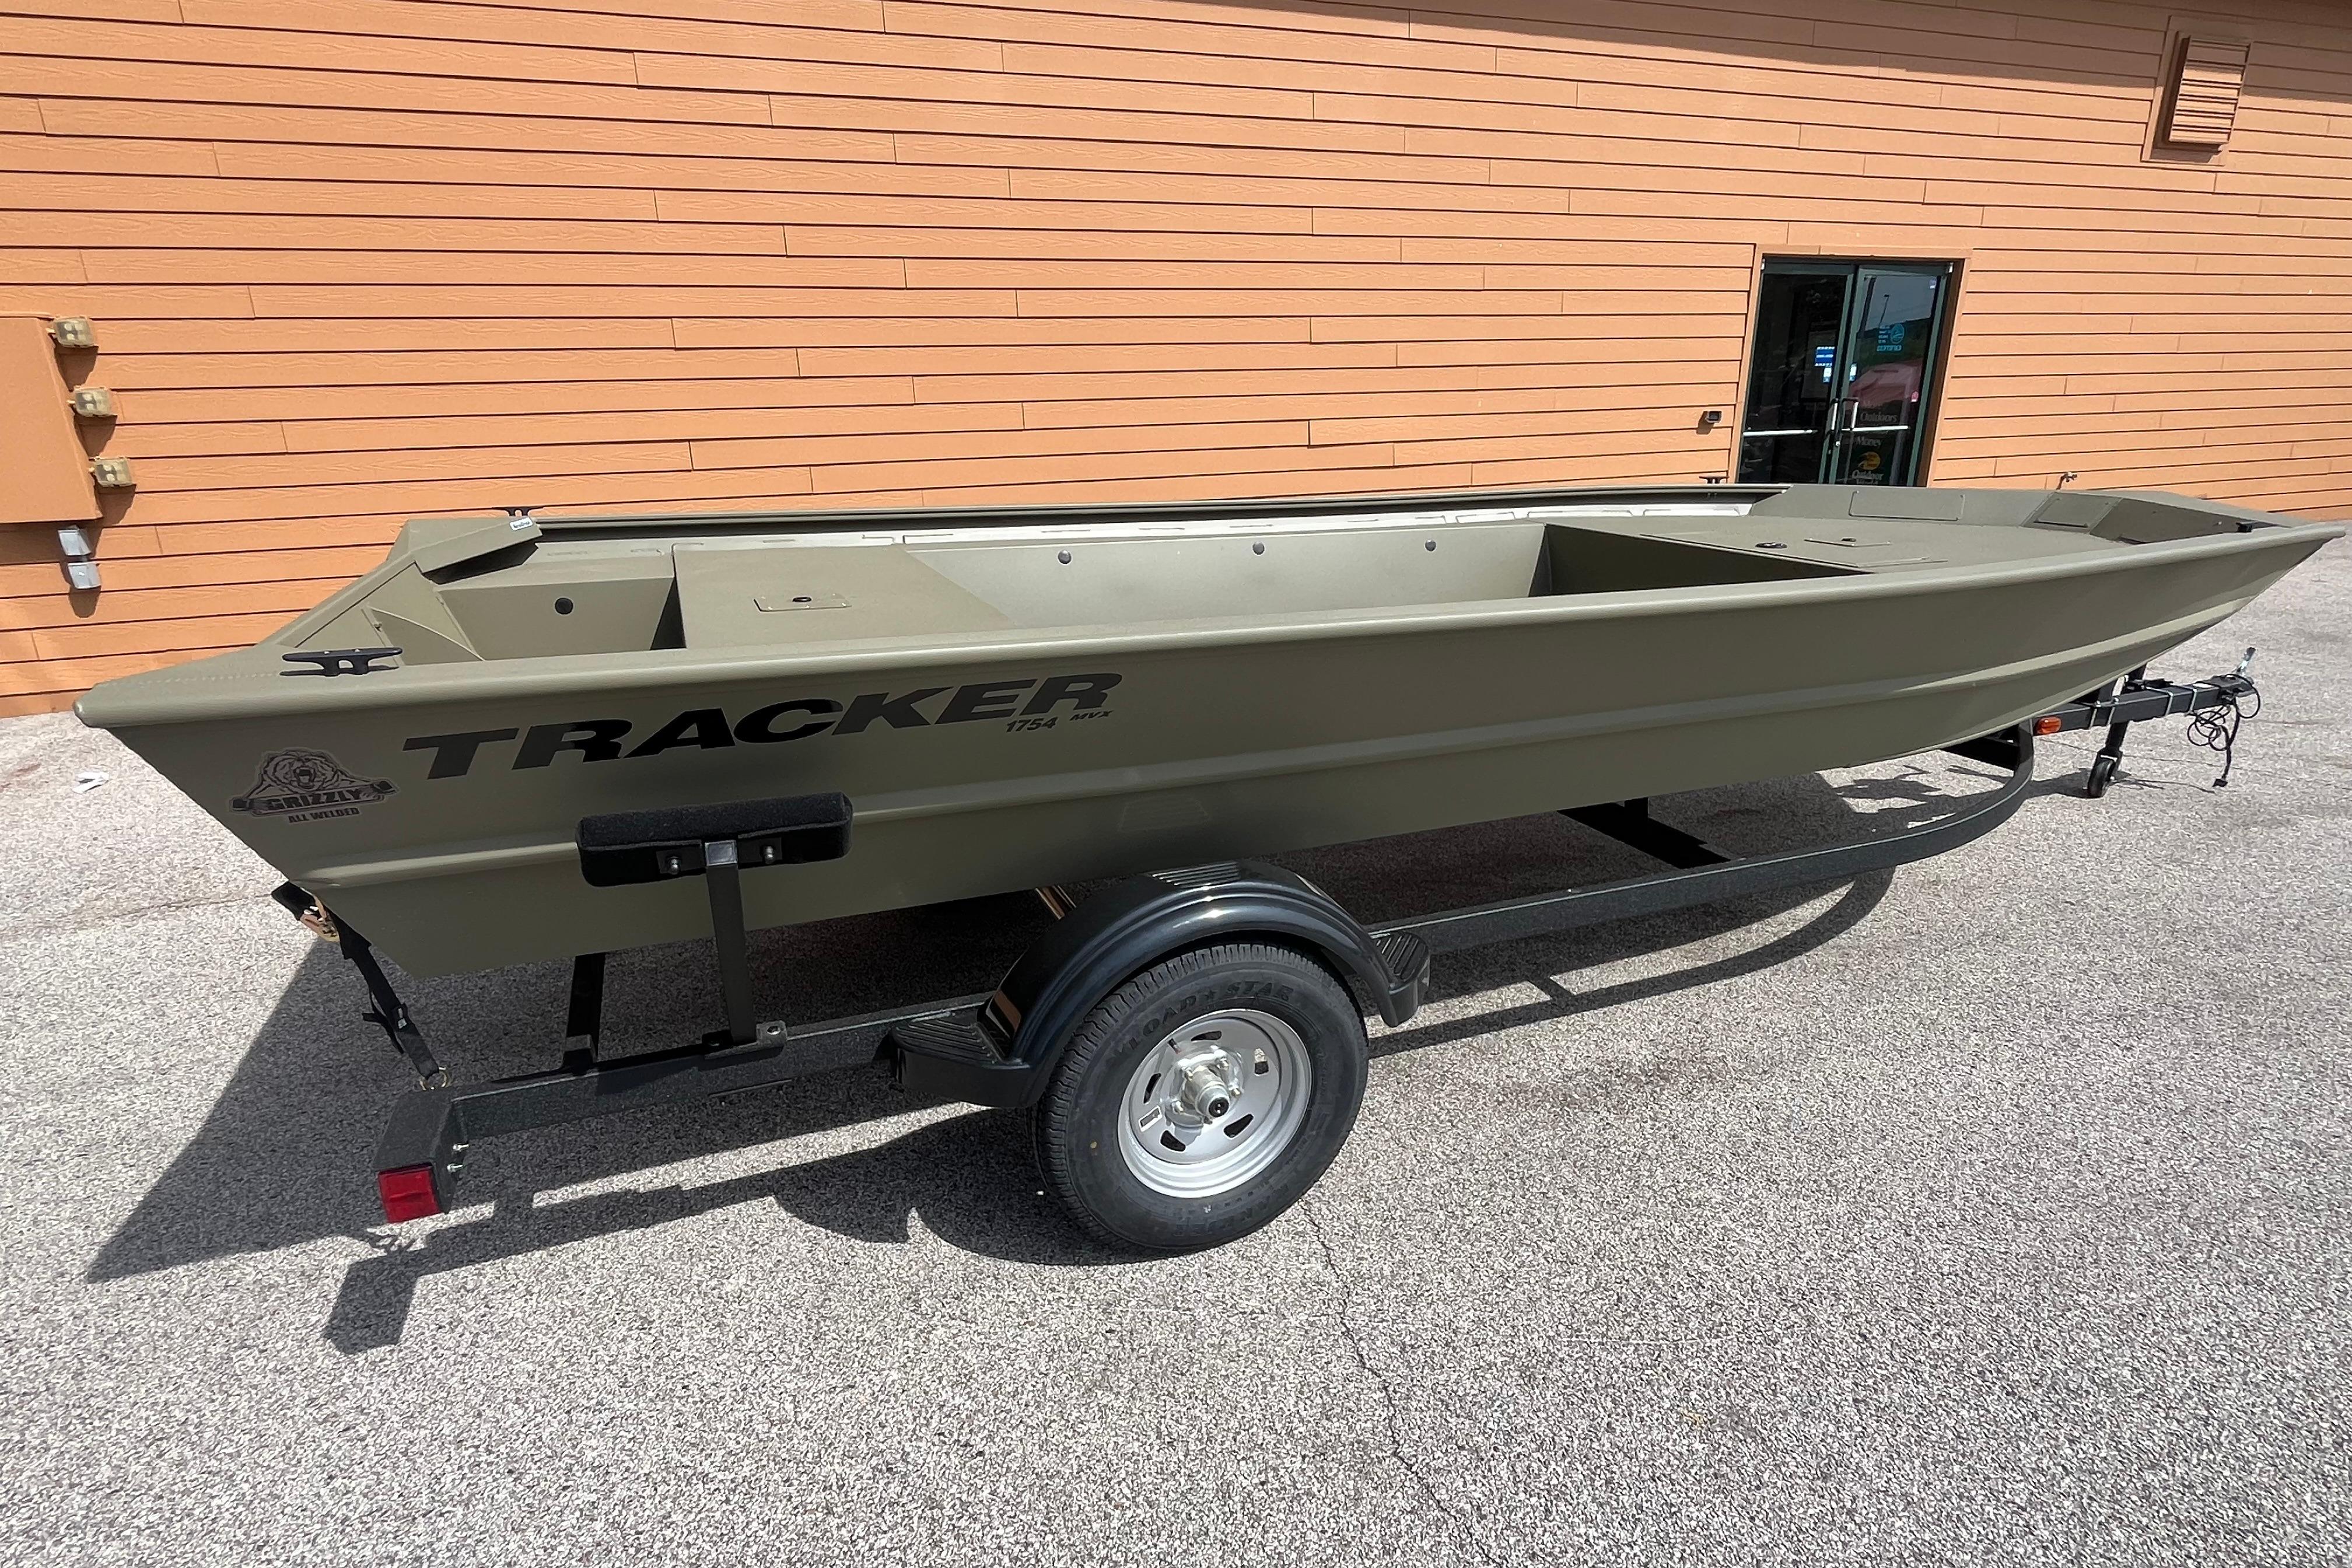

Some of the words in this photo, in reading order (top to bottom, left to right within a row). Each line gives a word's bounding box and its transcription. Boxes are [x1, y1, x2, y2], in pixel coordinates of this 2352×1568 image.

[402, 672, 1122, 780] TRACKER
[1006, 716, 1058, 733] 1754
[1069, 710, 1114, 722] MVX
[266, 788, 362, 811] GRIZZLY
[288, 814, 309, 824] ALL
[310, 807, 360, 821] WELDED
[1225, 981, 1294, 1002] STAR
